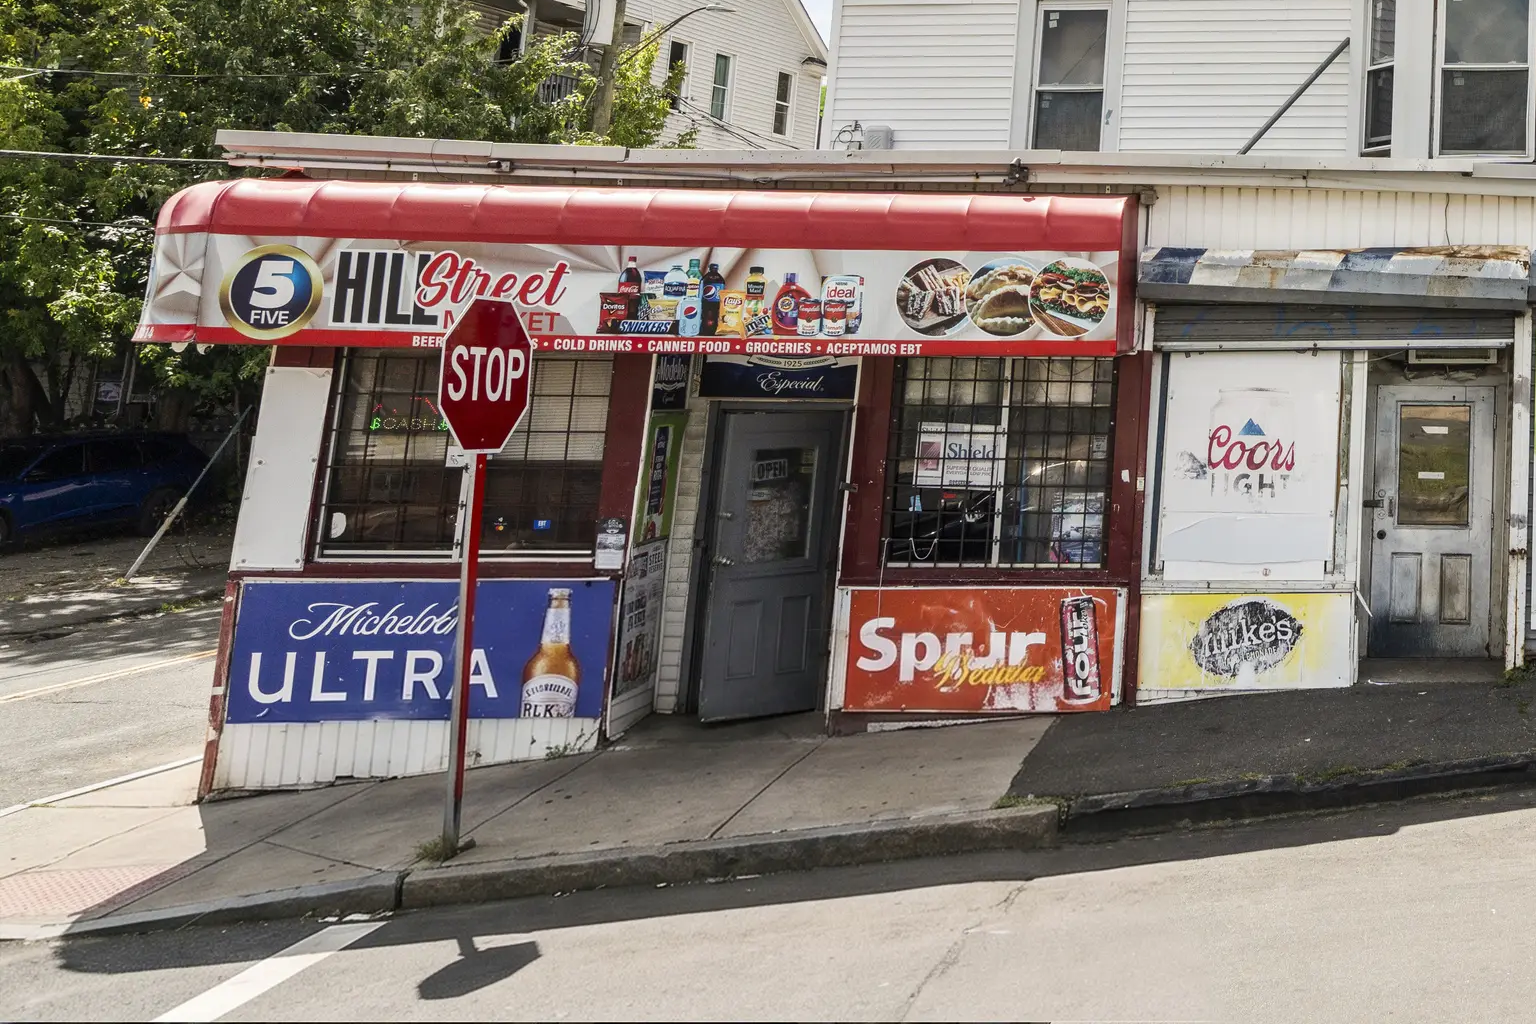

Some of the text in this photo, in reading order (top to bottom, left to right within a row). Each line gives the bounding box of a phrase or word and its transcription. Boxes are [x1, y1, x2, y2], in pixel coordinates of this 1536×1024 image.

[249, 260, 295, 309] 5
[332, 251, 439, 326] HILL
[416, 251, 571, 308] Street
[826, 286, 856, 299] ideal
[250, 310, 289, 325] FIVE
[602, 303, 625, 311] Doritos
[619, 321, 673, 333] SNICKERS
[412, 335, 444, 348] BEER
[554, 338, 923, 355] COLD DRINKS CANNED FOOD GROCERIES ACEPTAMOS EBT
[447, 345, 525, 403] STOP
[783, 360, 803, 368] 1925
[756, 371, 824, 395] Especial
[1207, 425, 1295, 472] Coors
[757, 459, 787, 480] OPEN
[246, 649, 499, 704] ULTRA
